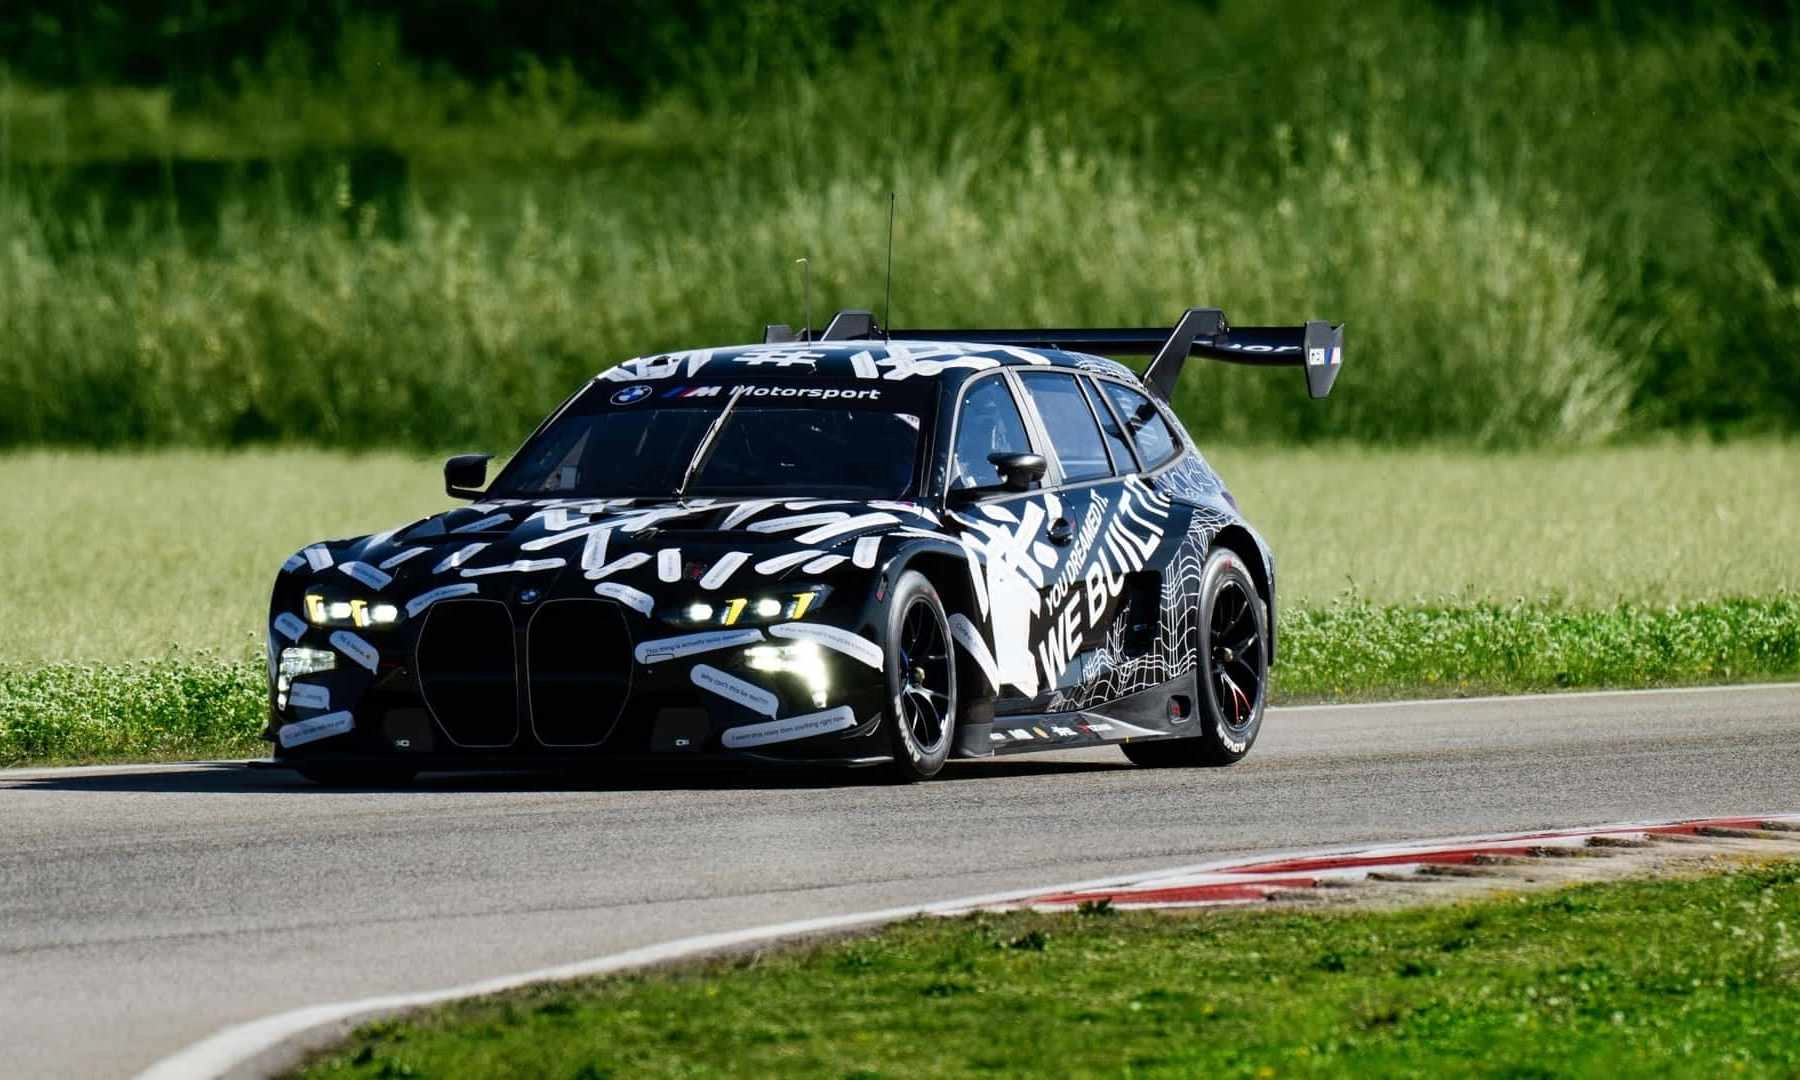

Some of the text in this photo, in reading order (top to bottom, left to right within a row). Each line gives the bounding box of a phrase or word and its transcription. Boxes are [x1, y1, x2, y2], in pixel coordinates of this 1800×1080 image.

[730, 385, 881, 400] Motorsport
[1038, 593, 1083, 692] WE
[1086, 489, 1165, 629] BUILT
[1045, 570, 1069, 616] YOU
[1066, 501, 1102, 585] DREAMED
